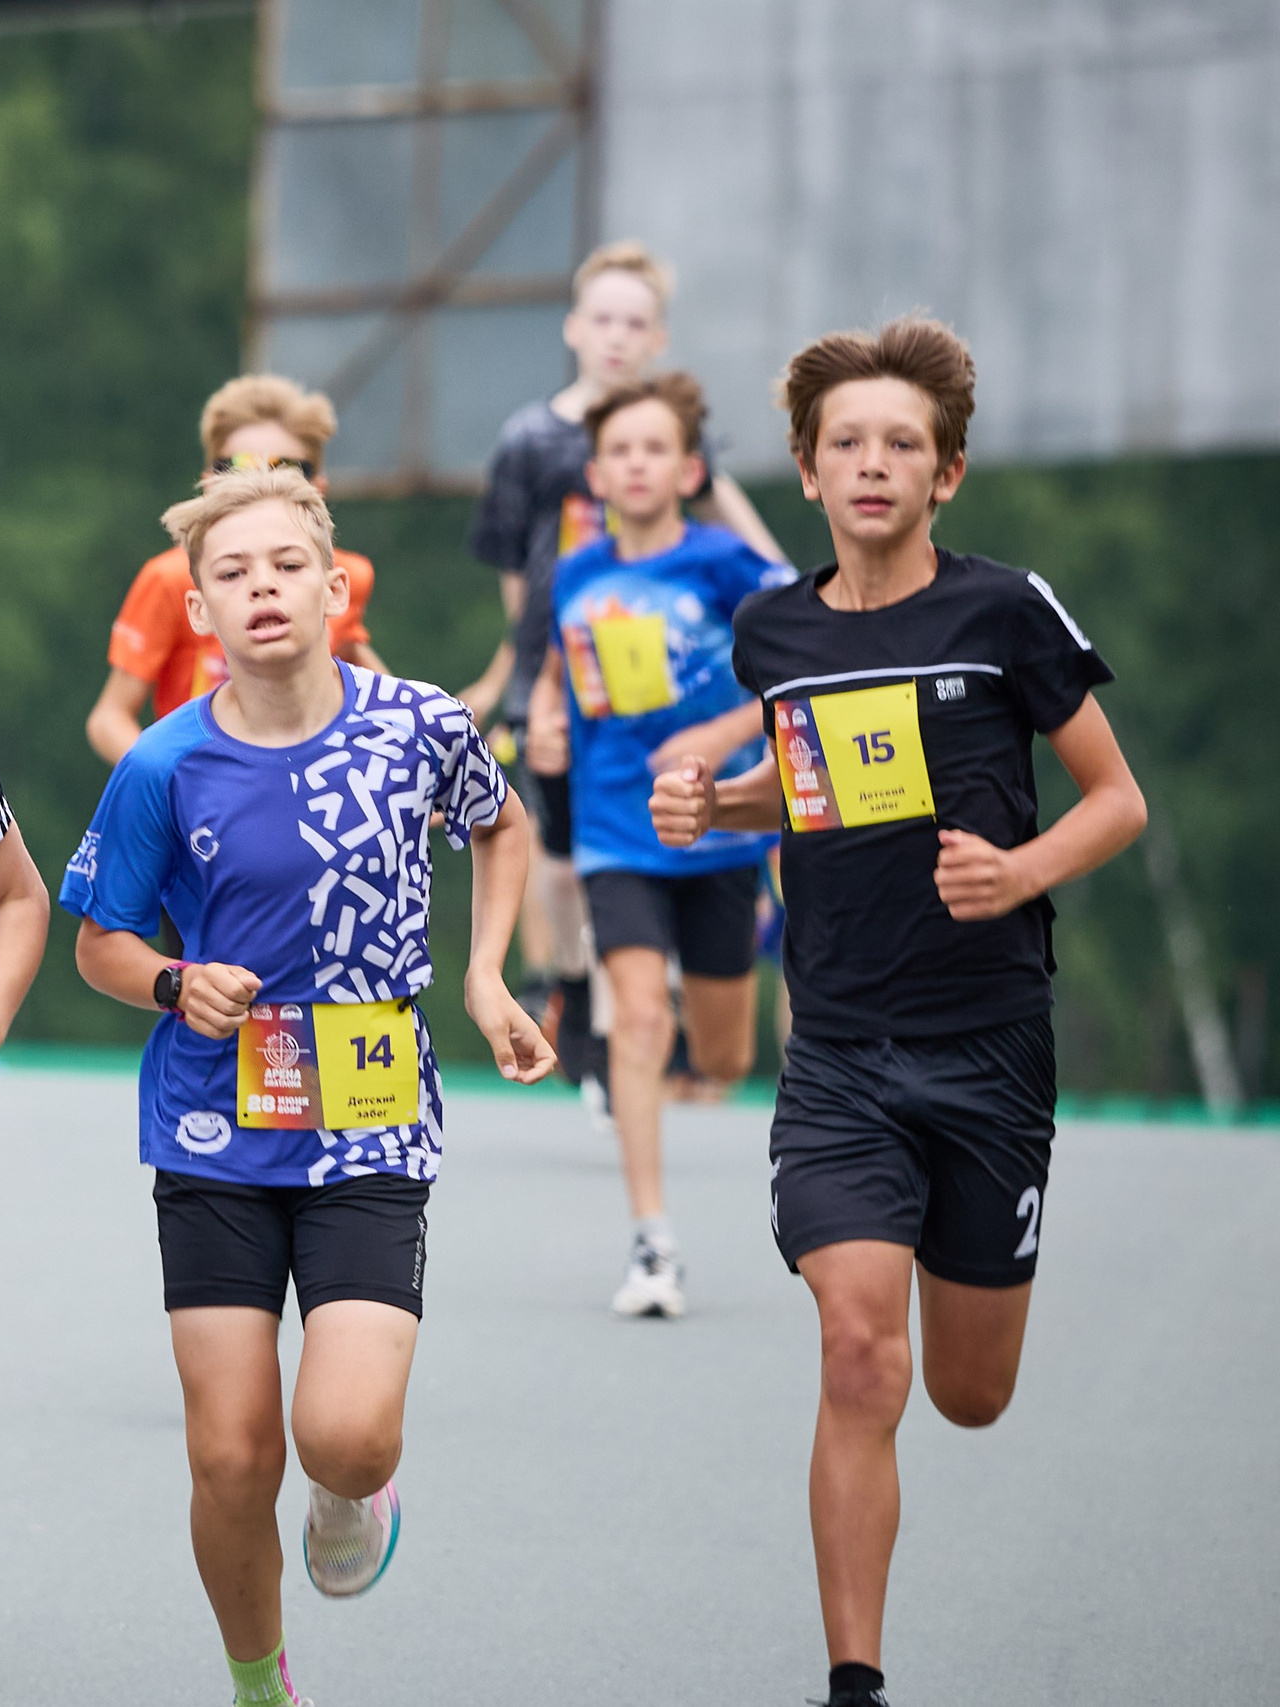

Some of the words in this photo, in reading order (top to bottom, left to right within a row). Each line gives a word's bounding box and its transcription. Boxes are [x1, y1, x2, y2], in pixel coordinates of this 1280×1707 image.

[852, 730, 895, 765] 15
[859, 786, 905, 801] Детский
[350, 1034, 395, 1071] 14
[264, 1067, 302, 1080] АРЕНА
[247, 1094, 276, 1114] 28
[347, 1093, 396, 1107] Детский
[356, 1109, 388, 1120] забег
[1012, 1185, 1040, 1260] 2
